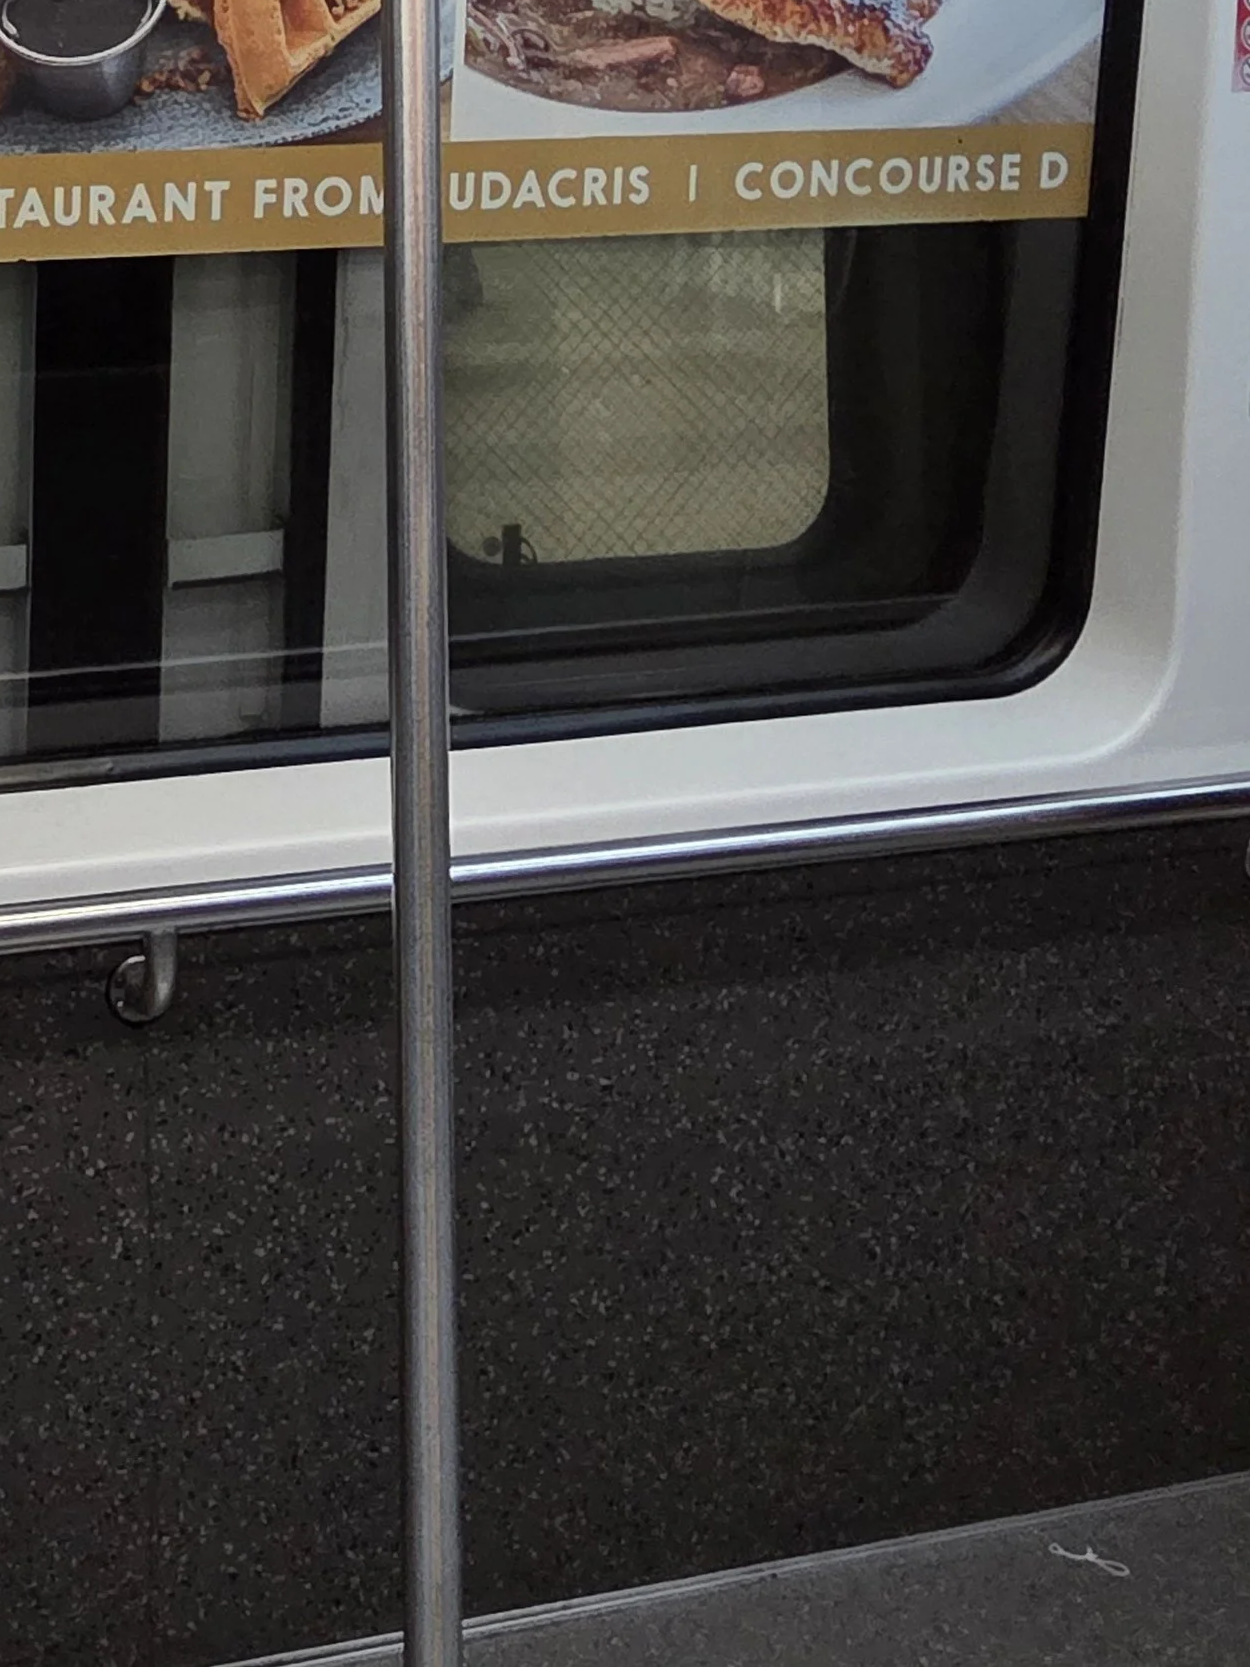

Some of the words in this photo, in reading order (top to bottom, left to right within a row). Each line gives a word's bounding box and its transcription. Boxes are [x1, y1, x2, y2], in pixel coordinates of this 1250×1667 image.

[449, 165, 651, 210] UDACRIS
[735, 151, 1021, 202] CONCOURSE
[1039, 151, 1070, 191] D
